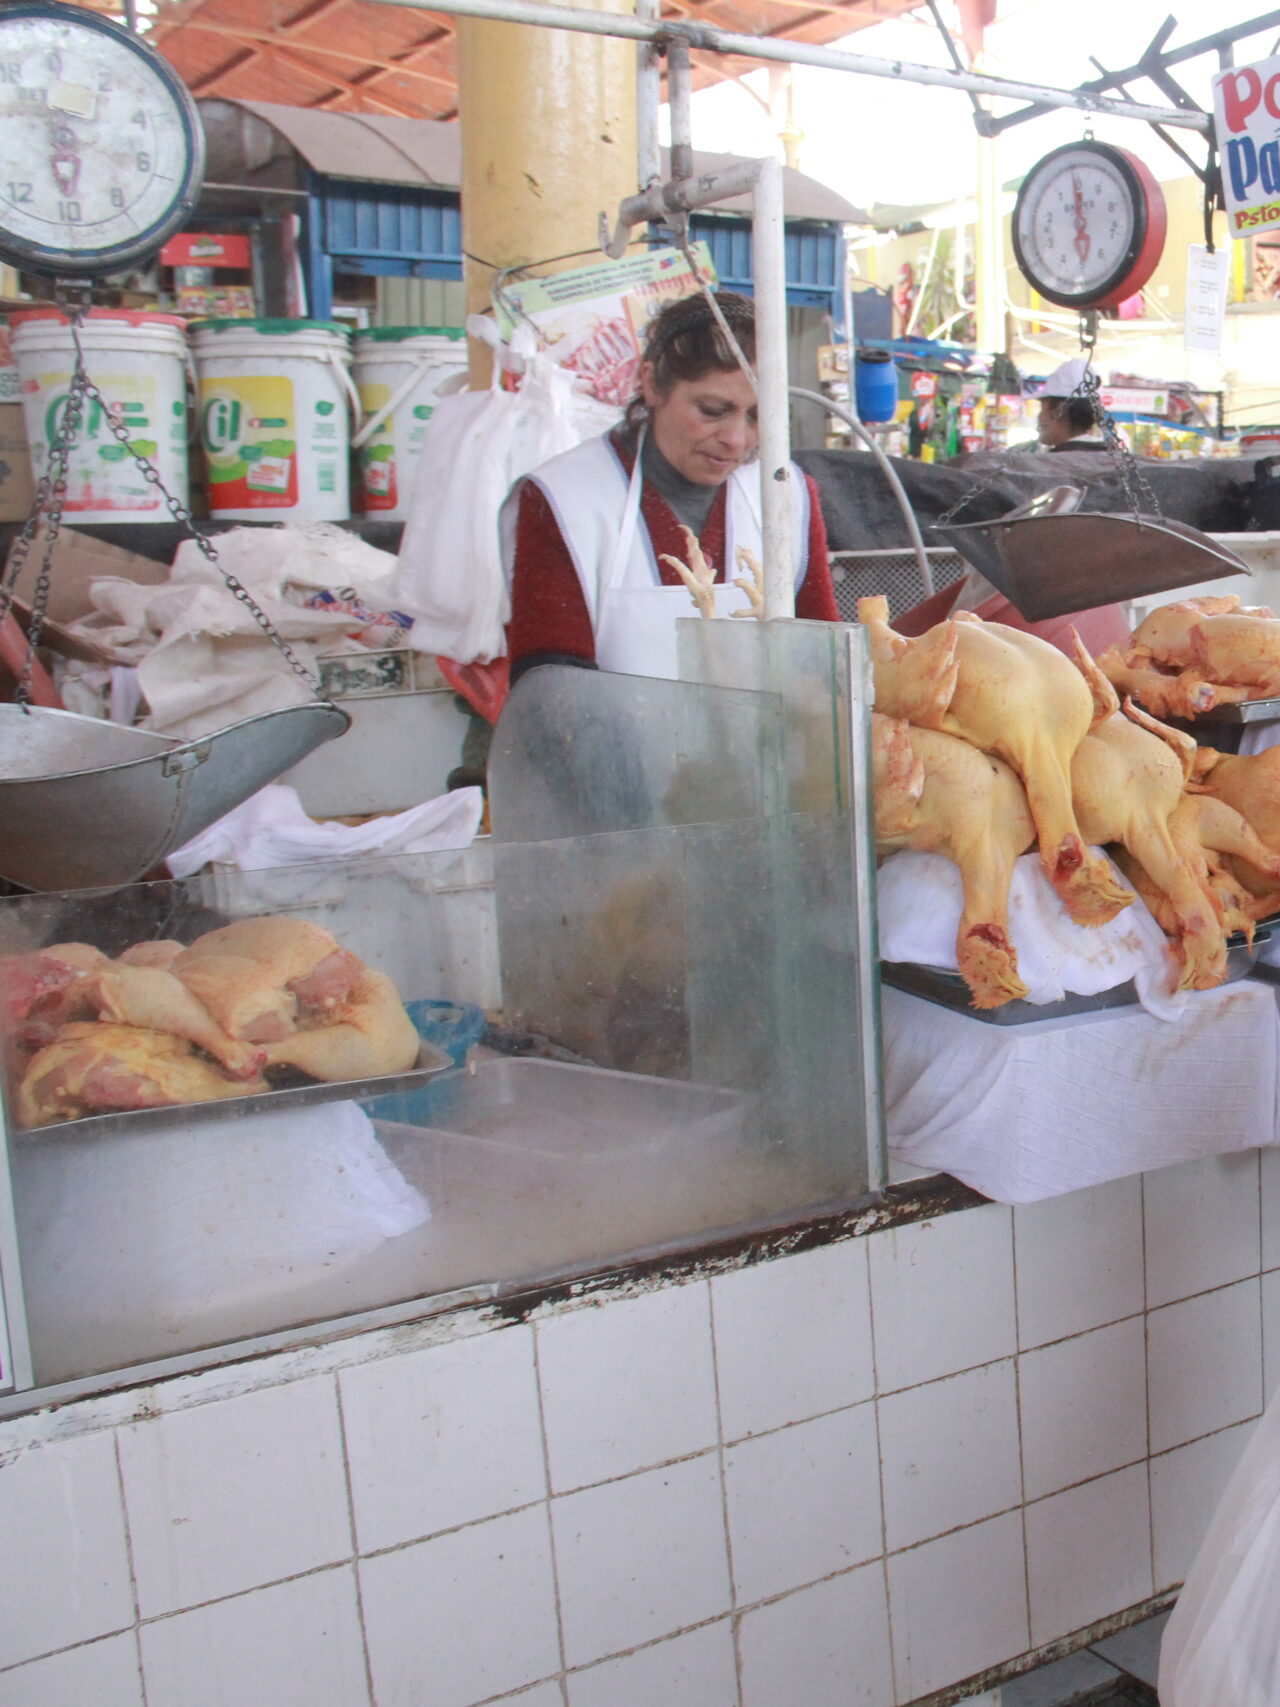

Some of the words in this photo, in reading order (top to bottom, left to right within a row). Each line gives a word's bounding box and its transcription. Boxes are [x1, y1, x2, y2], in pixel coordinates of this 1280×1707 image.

[98, 73, 112, 91] 2
[131, 109, 146, 129] 4
[136, 152, 150, 172] 6
[6, 182, 34, 203] 12
[110, 187, 125, 208] 8
[58, 201, 82, 222] 10
